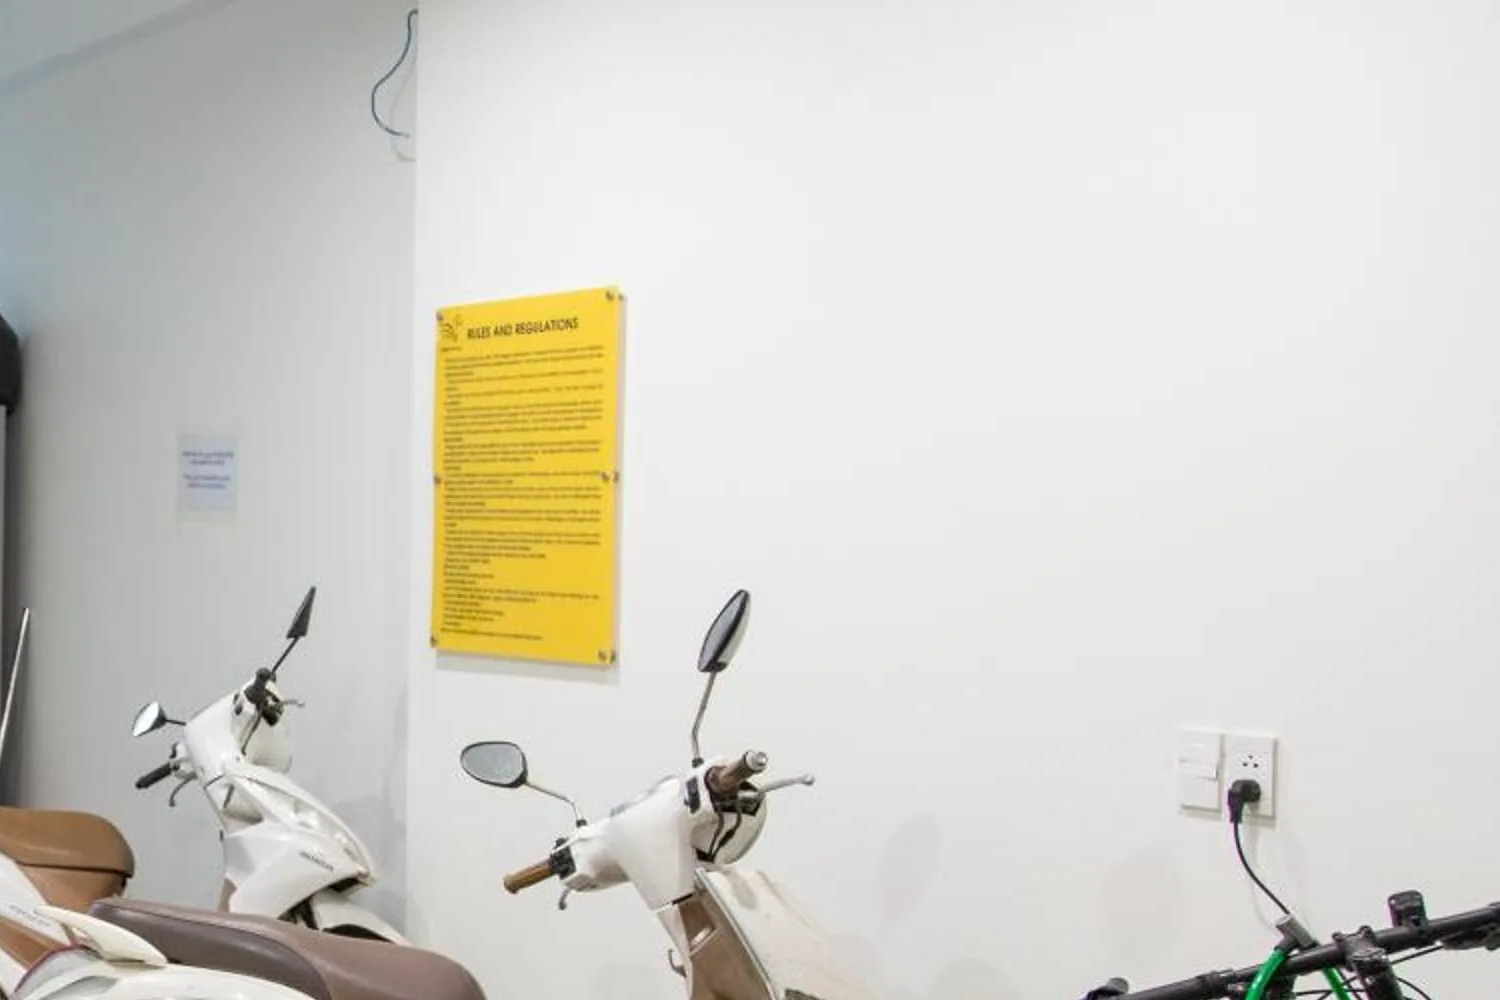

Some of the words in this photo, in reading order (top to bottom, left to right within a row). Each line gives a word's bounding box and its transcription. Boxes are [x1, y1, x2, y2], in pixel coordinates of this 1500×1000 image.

[467, 326, 491, 340] RULES
[493, 323, 513, 336] AND
[515, 317, 579, 335] REGULATIONS
